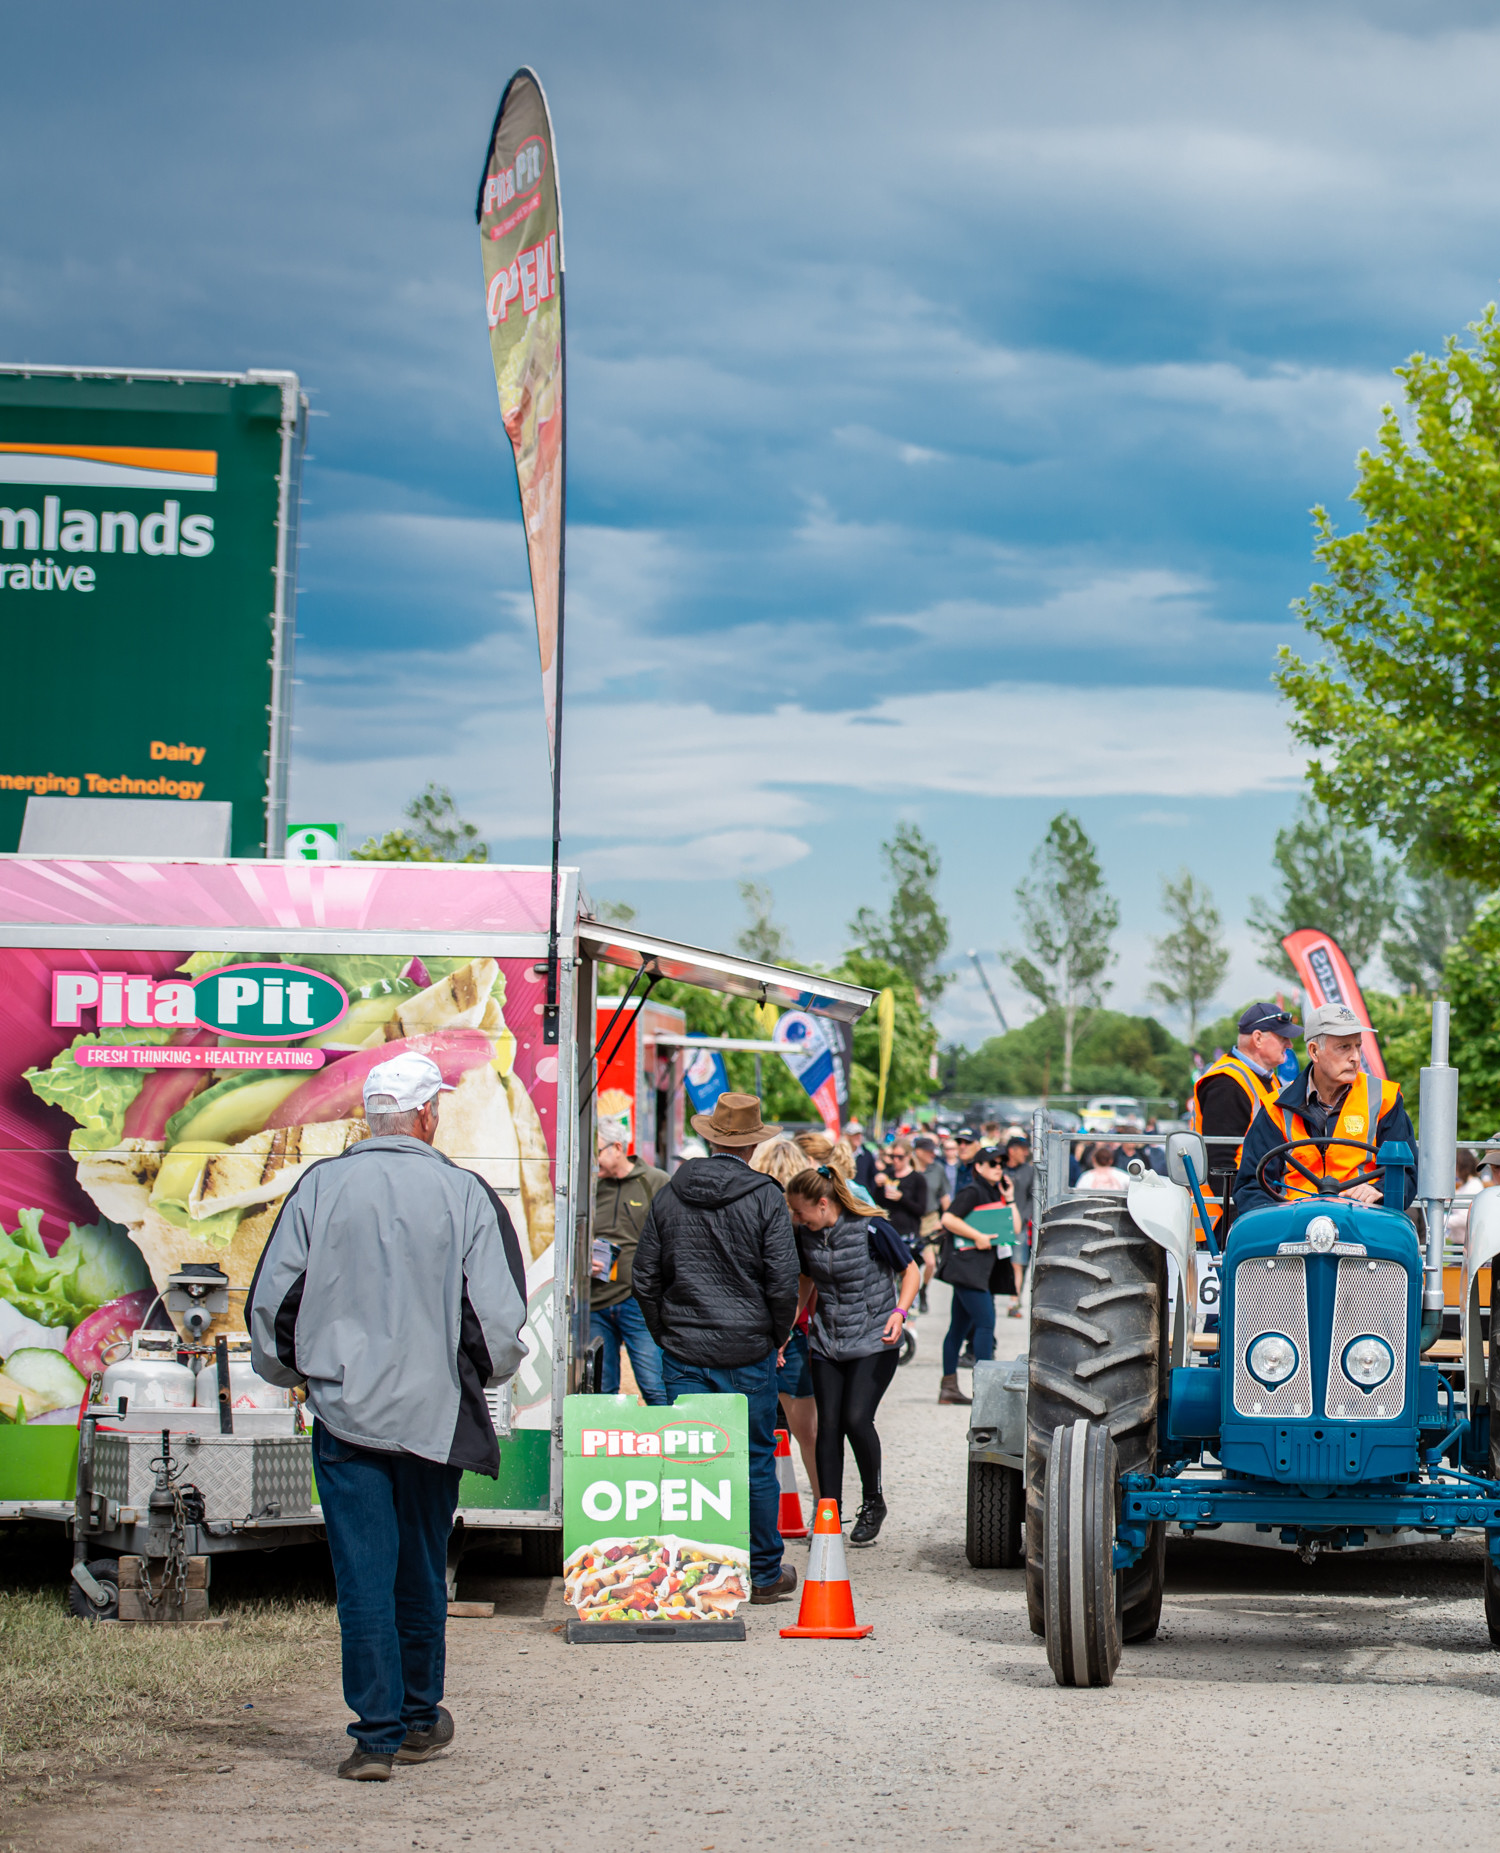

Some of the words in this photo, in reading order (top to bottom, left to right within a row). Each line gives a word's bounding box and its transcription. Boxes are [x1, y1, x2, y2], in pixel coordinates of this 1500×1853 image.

[150, 740, 206, 766] Dairy
[84, 773, 205, 800] Technology
[56, 974, 197, 1024] Pita
[217, 976, 315, 1025] Pit
[87, 1049, 128, 1063] FRESH
[131, 1049, 192, 1064] THINKING
[204, 1051, 264, 1065] HEALTHY
[266, 1052, 313, 1065] EATING
[1281, 1245, 1309, 1255] SUPER
[583, 1430, 661, 1456] Pita
[663, 1430, 717, 1455] Pit
[581, 1478, 732, 1522] OPEN
